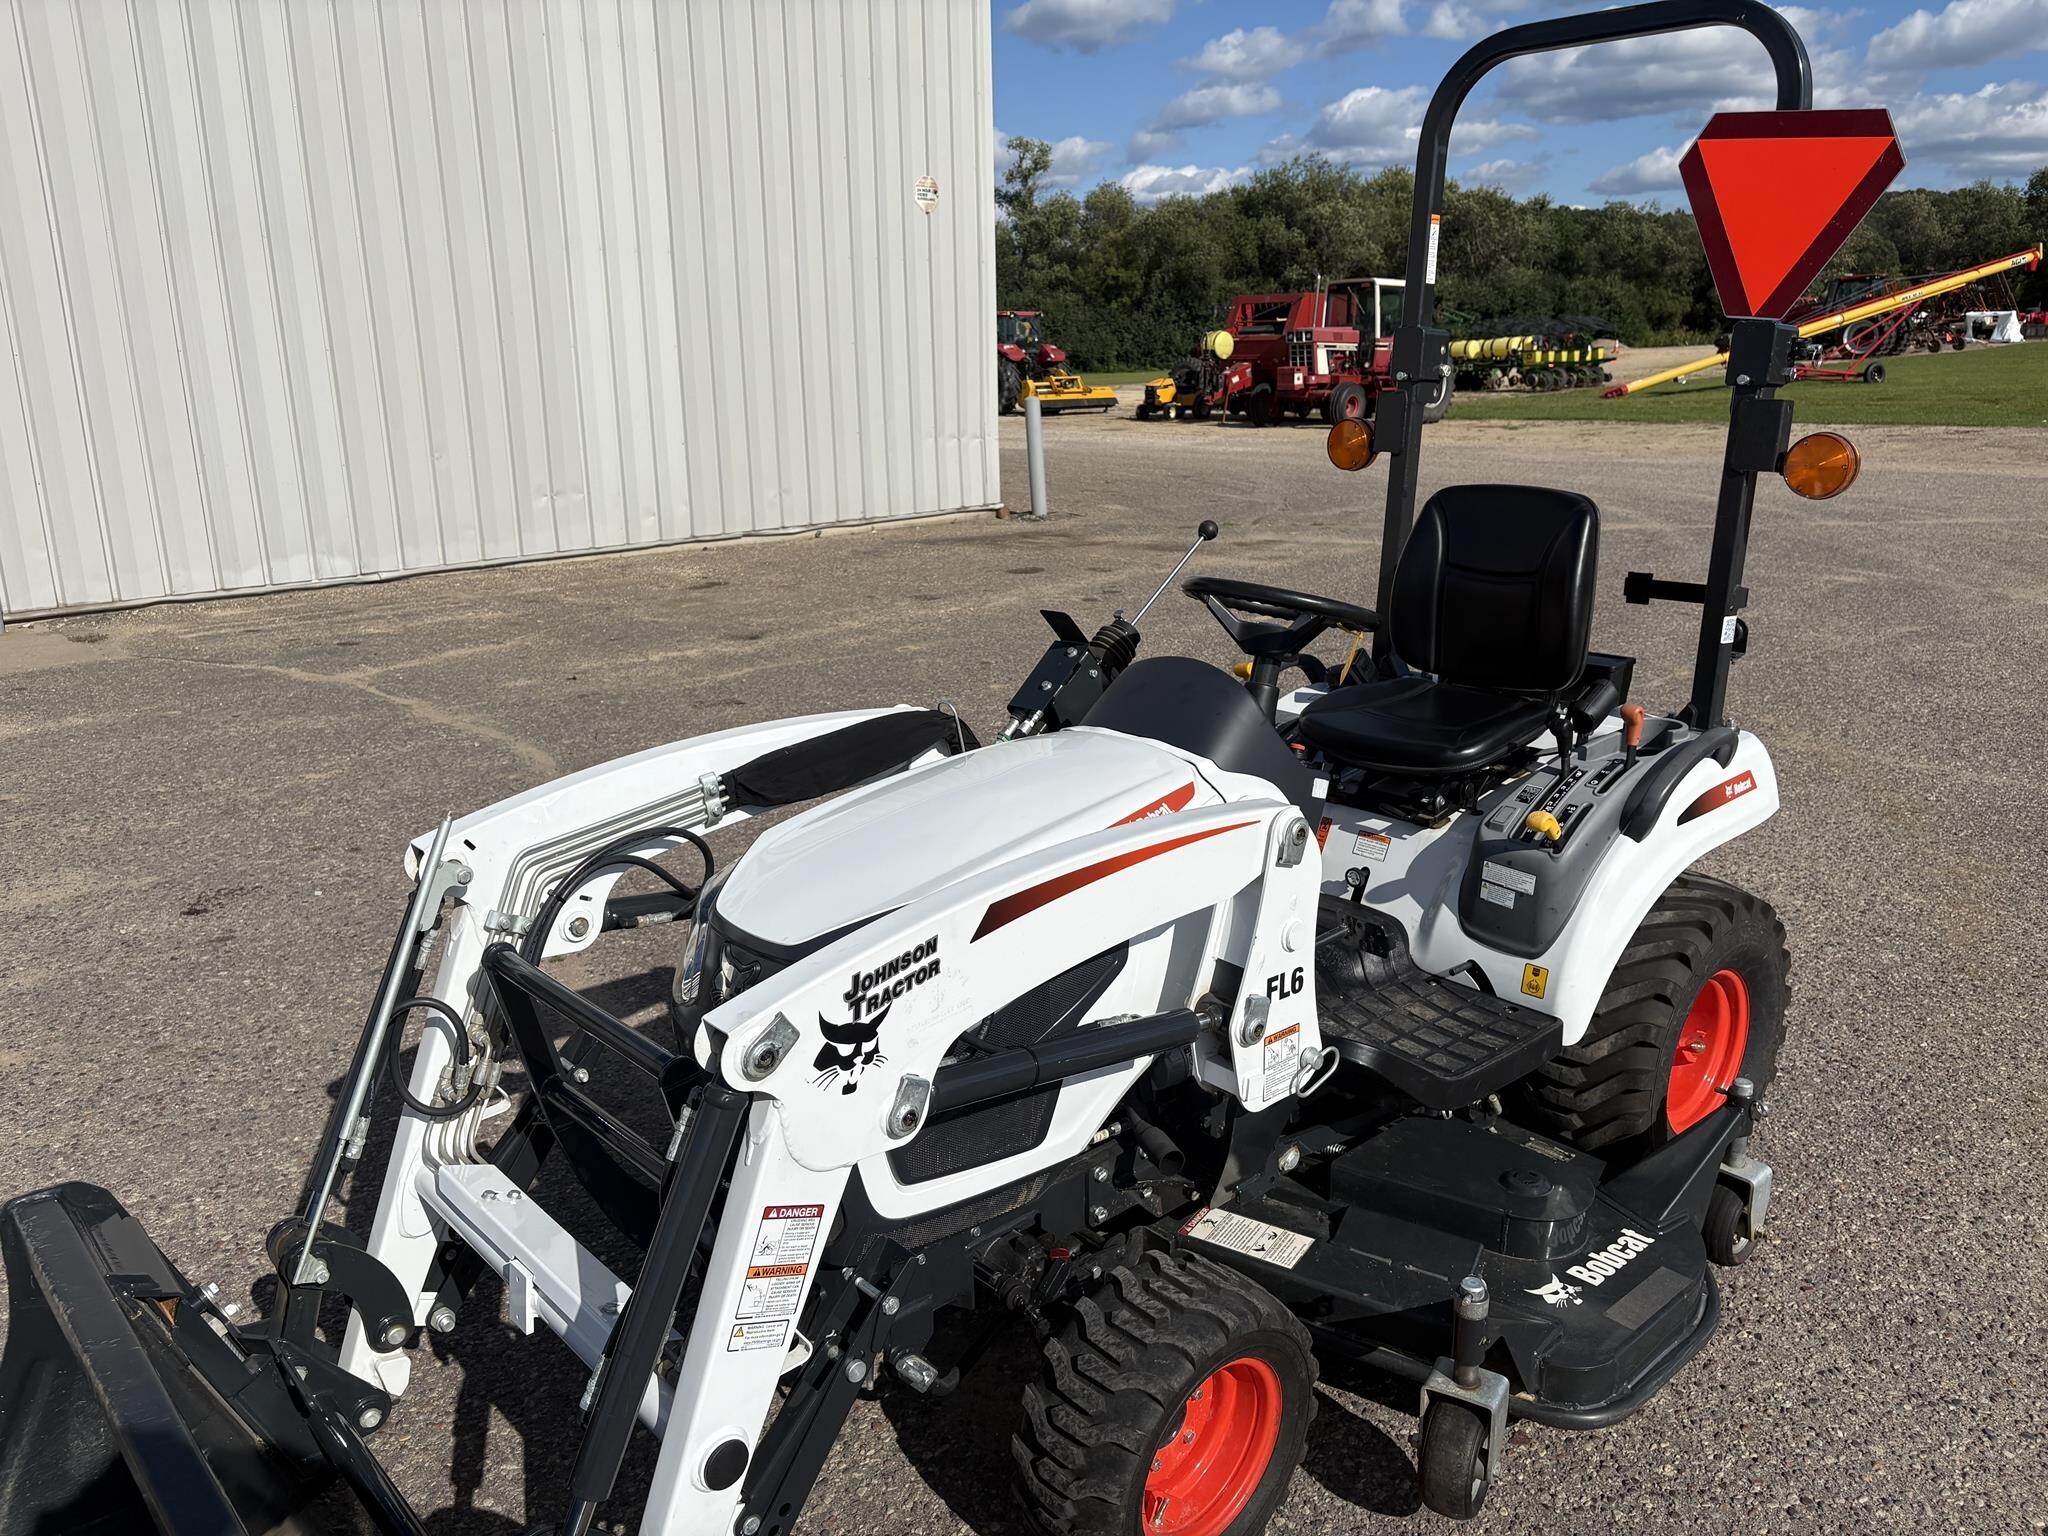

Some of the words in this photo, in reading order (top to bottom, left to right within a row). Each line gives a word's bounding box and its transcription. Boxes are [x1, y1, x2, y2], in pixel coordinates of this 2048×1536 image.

[843, 934, 939, 1003] JOHNSON
[848, 958, 941, 1023] TRACTOR
[1266, 966, 1304, 1004] FL6
[779, 1207, 818, 1218] DANGER
[762, 1265, 803, 1276] WARNING
[1565, 1227, 1656, 1287] Bobcat
